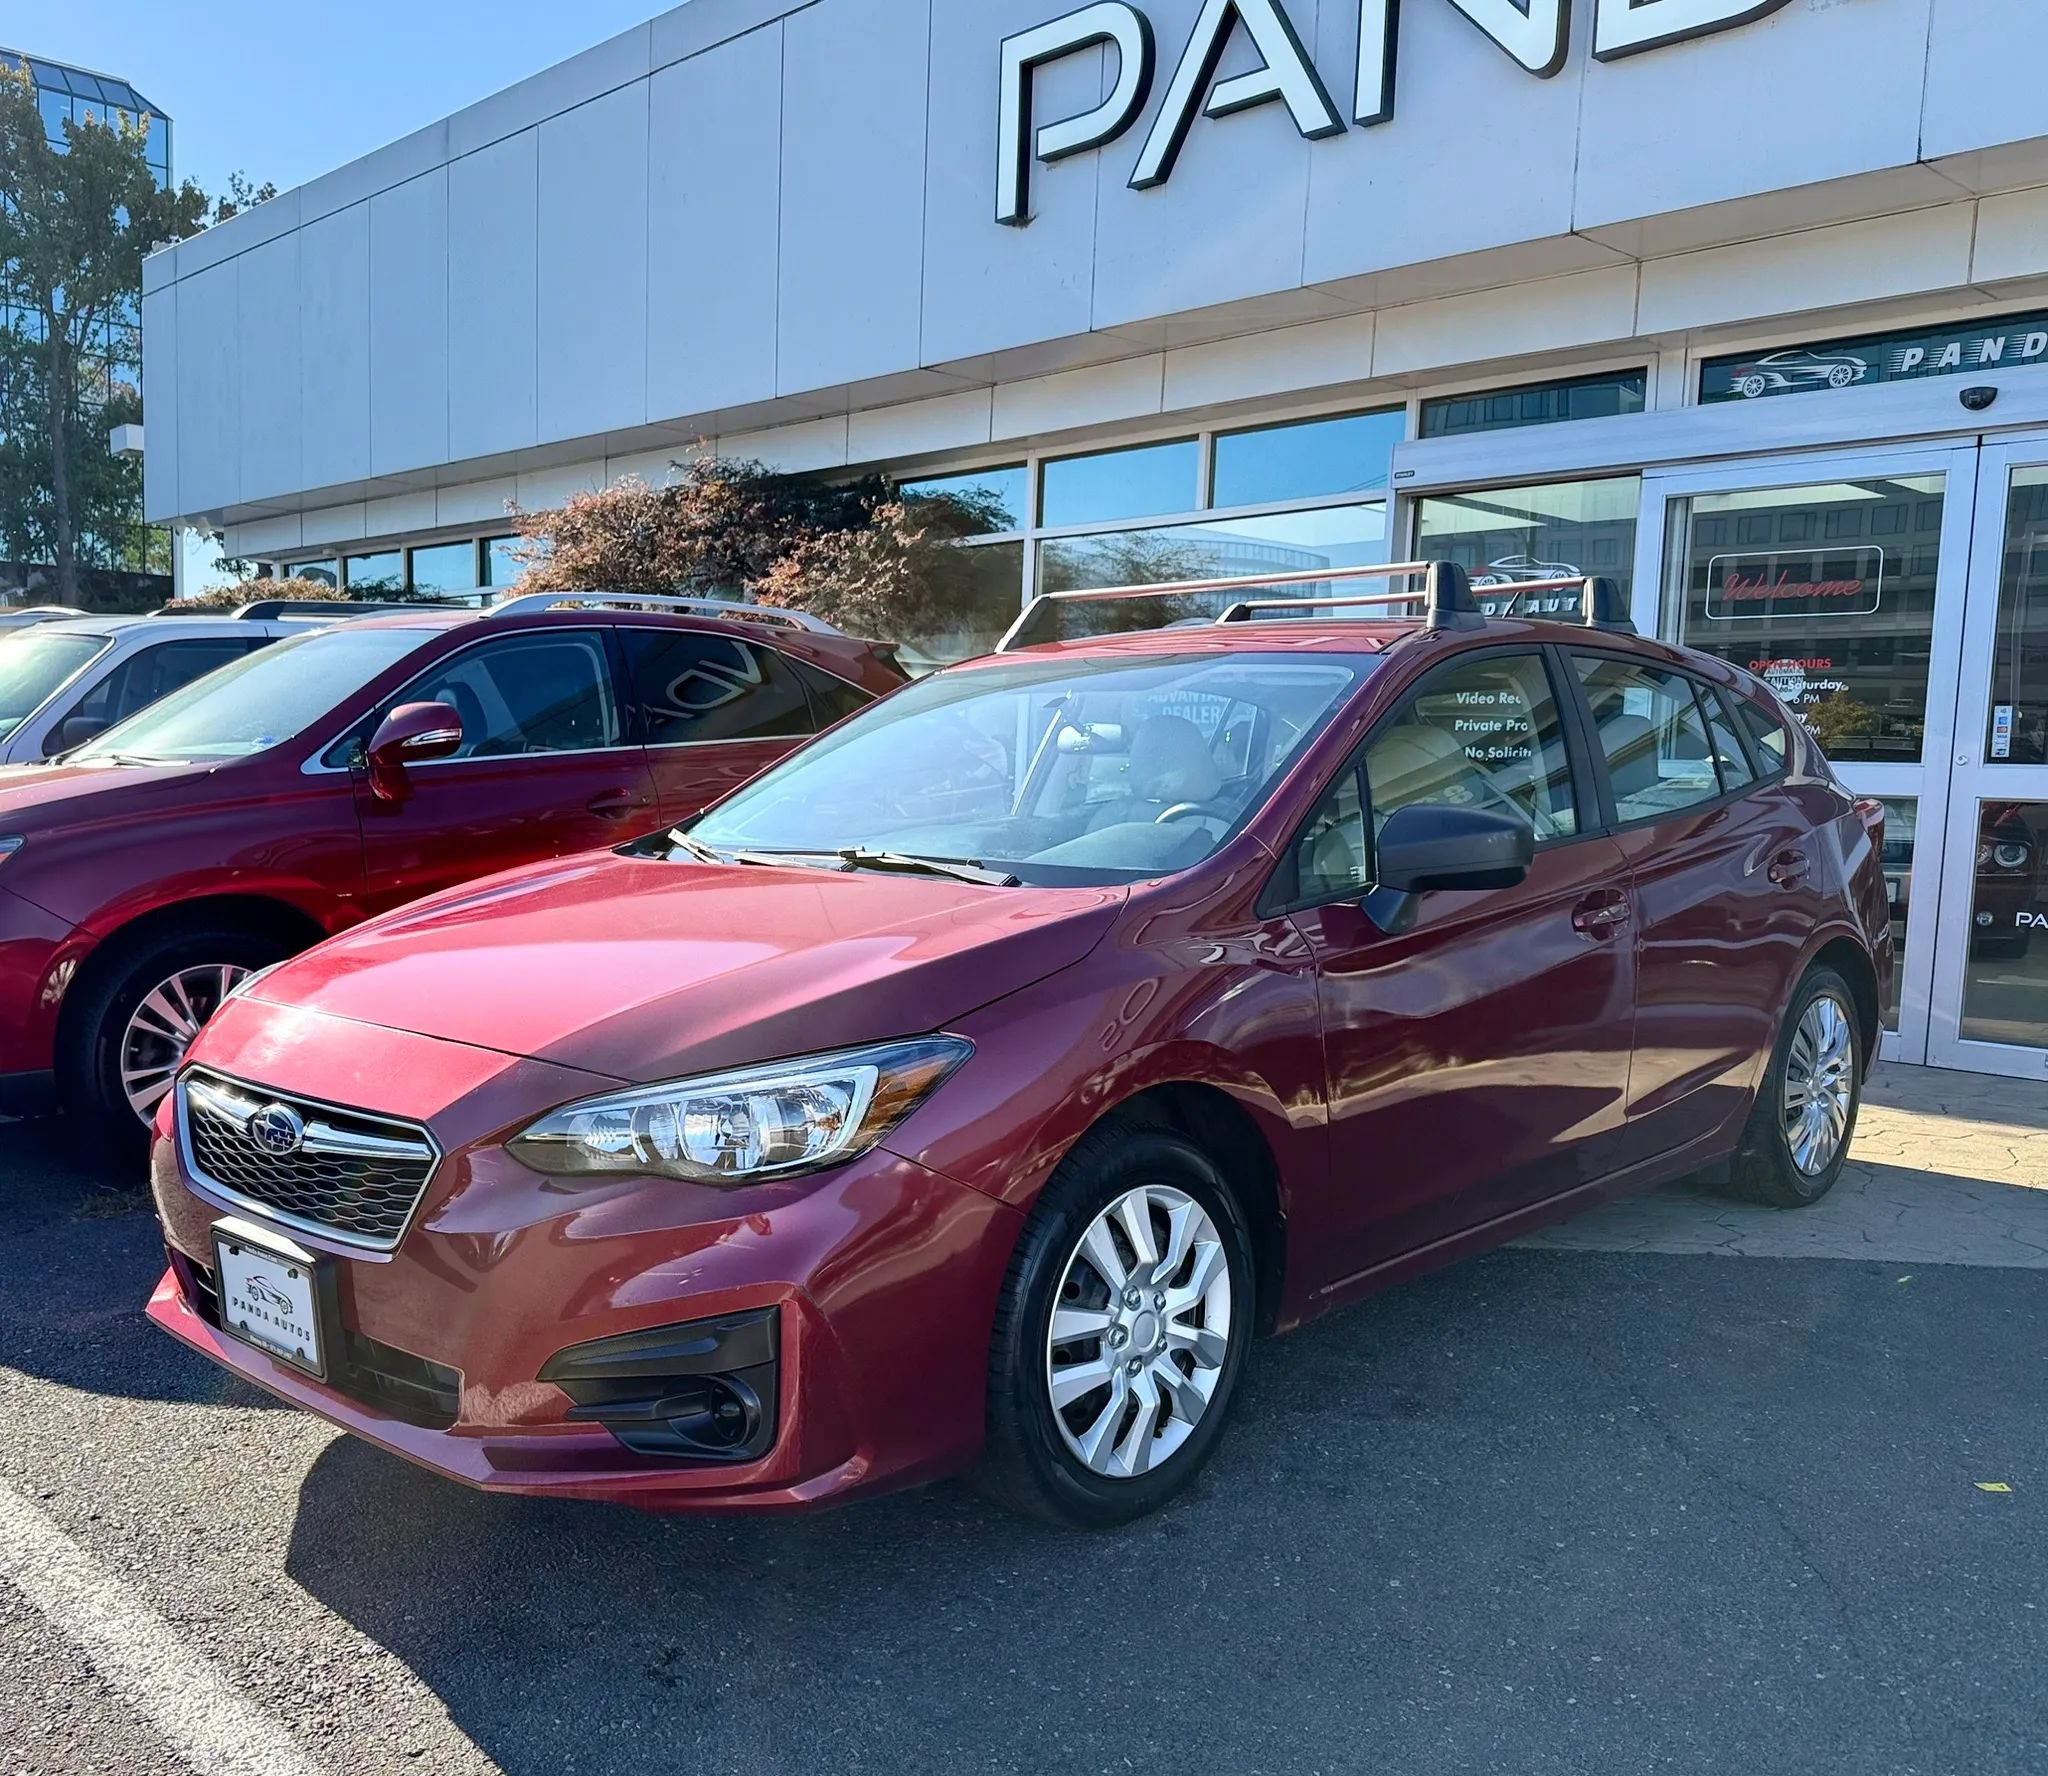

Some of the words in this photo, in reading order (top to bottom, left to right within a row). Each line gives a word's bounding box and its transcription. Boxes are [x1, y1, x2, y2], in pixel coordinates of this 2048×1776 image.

[1722, 569, 1863, 601] Welcome
[1787, 658, 1832, 669] HOURS
[1456, 691, 1495, 705] Video
[1803, 693, 1820, 704] PM
[1454, 718, 1503, 731] Private
[1464, 746, 1484, 758] No
[232, 1297, 270, 1321] PANDA
[275, 1316, 311, 1342] AUTOS
